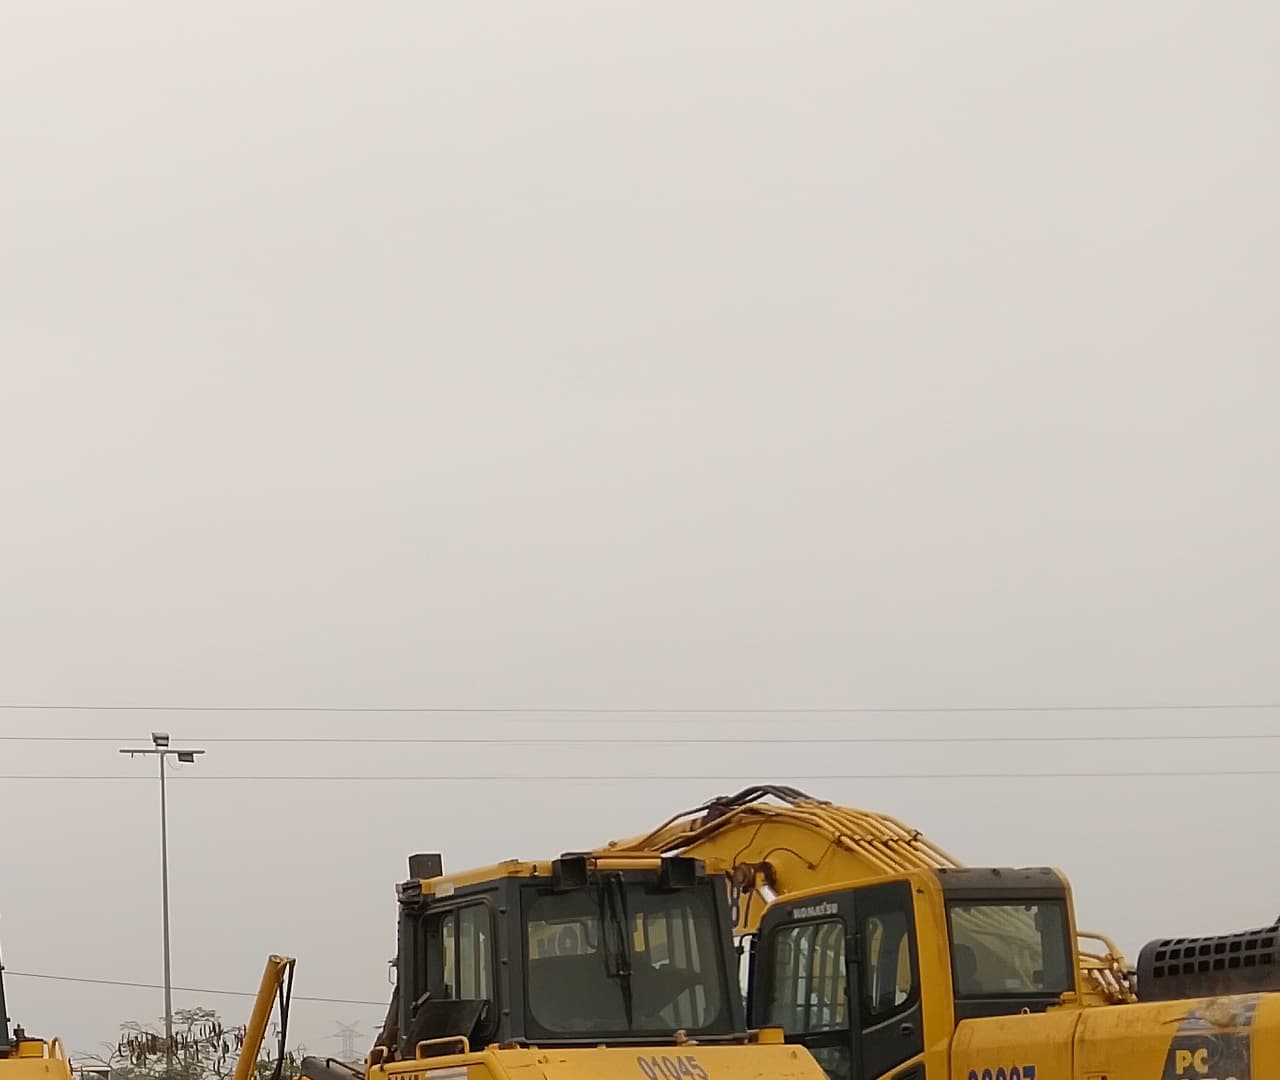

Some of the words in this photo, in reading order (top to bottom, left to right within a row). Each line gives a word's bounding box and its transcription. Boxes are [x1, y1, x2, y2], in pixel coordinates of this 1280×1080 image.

[793, 902, 838, 919] KOMATSU
[637, 1055, 709, 1080] 01045
[1175, 1048, 1209, 1074] PC
